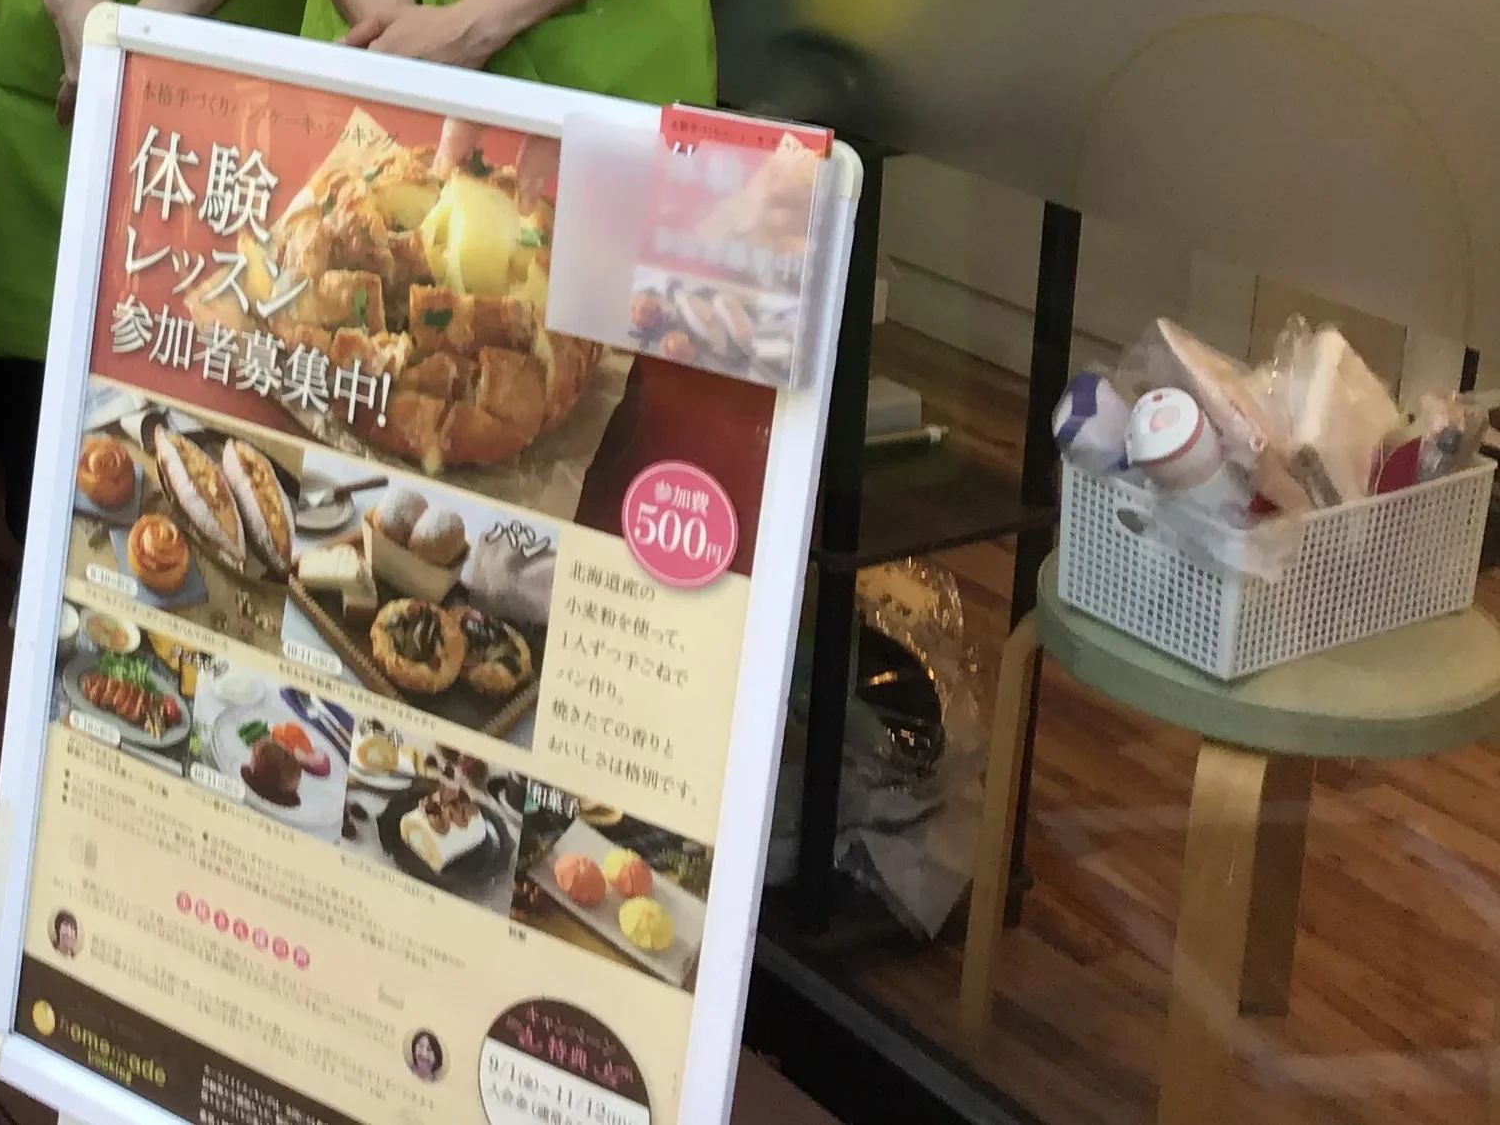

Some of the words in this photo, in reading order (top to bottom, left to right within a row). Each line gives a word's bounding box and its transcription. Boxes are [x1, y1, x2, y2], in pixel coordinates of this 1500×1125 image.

[127, 123, 278, 242] 体験
[121, 224, 311, 319] レッスン
[110, 297, 391, 430] 参加者募集中!
[654, 478, 710, 514] 参加費
[484, 518, 552, 557] パン
[634, 502, 723, 565] 500円
[568, 560, 657, 603] 北海道産の
[564, 594, 687, 653] 小麦粉を使って、
[556, 666, 625, 706] パン作り。
[560, 630, 690, 688] 1人ずつ手こねで
[552, 697, 676, 760] 焼きたての香りと
[548, 733, 698, 807] おいしさは格別です。
